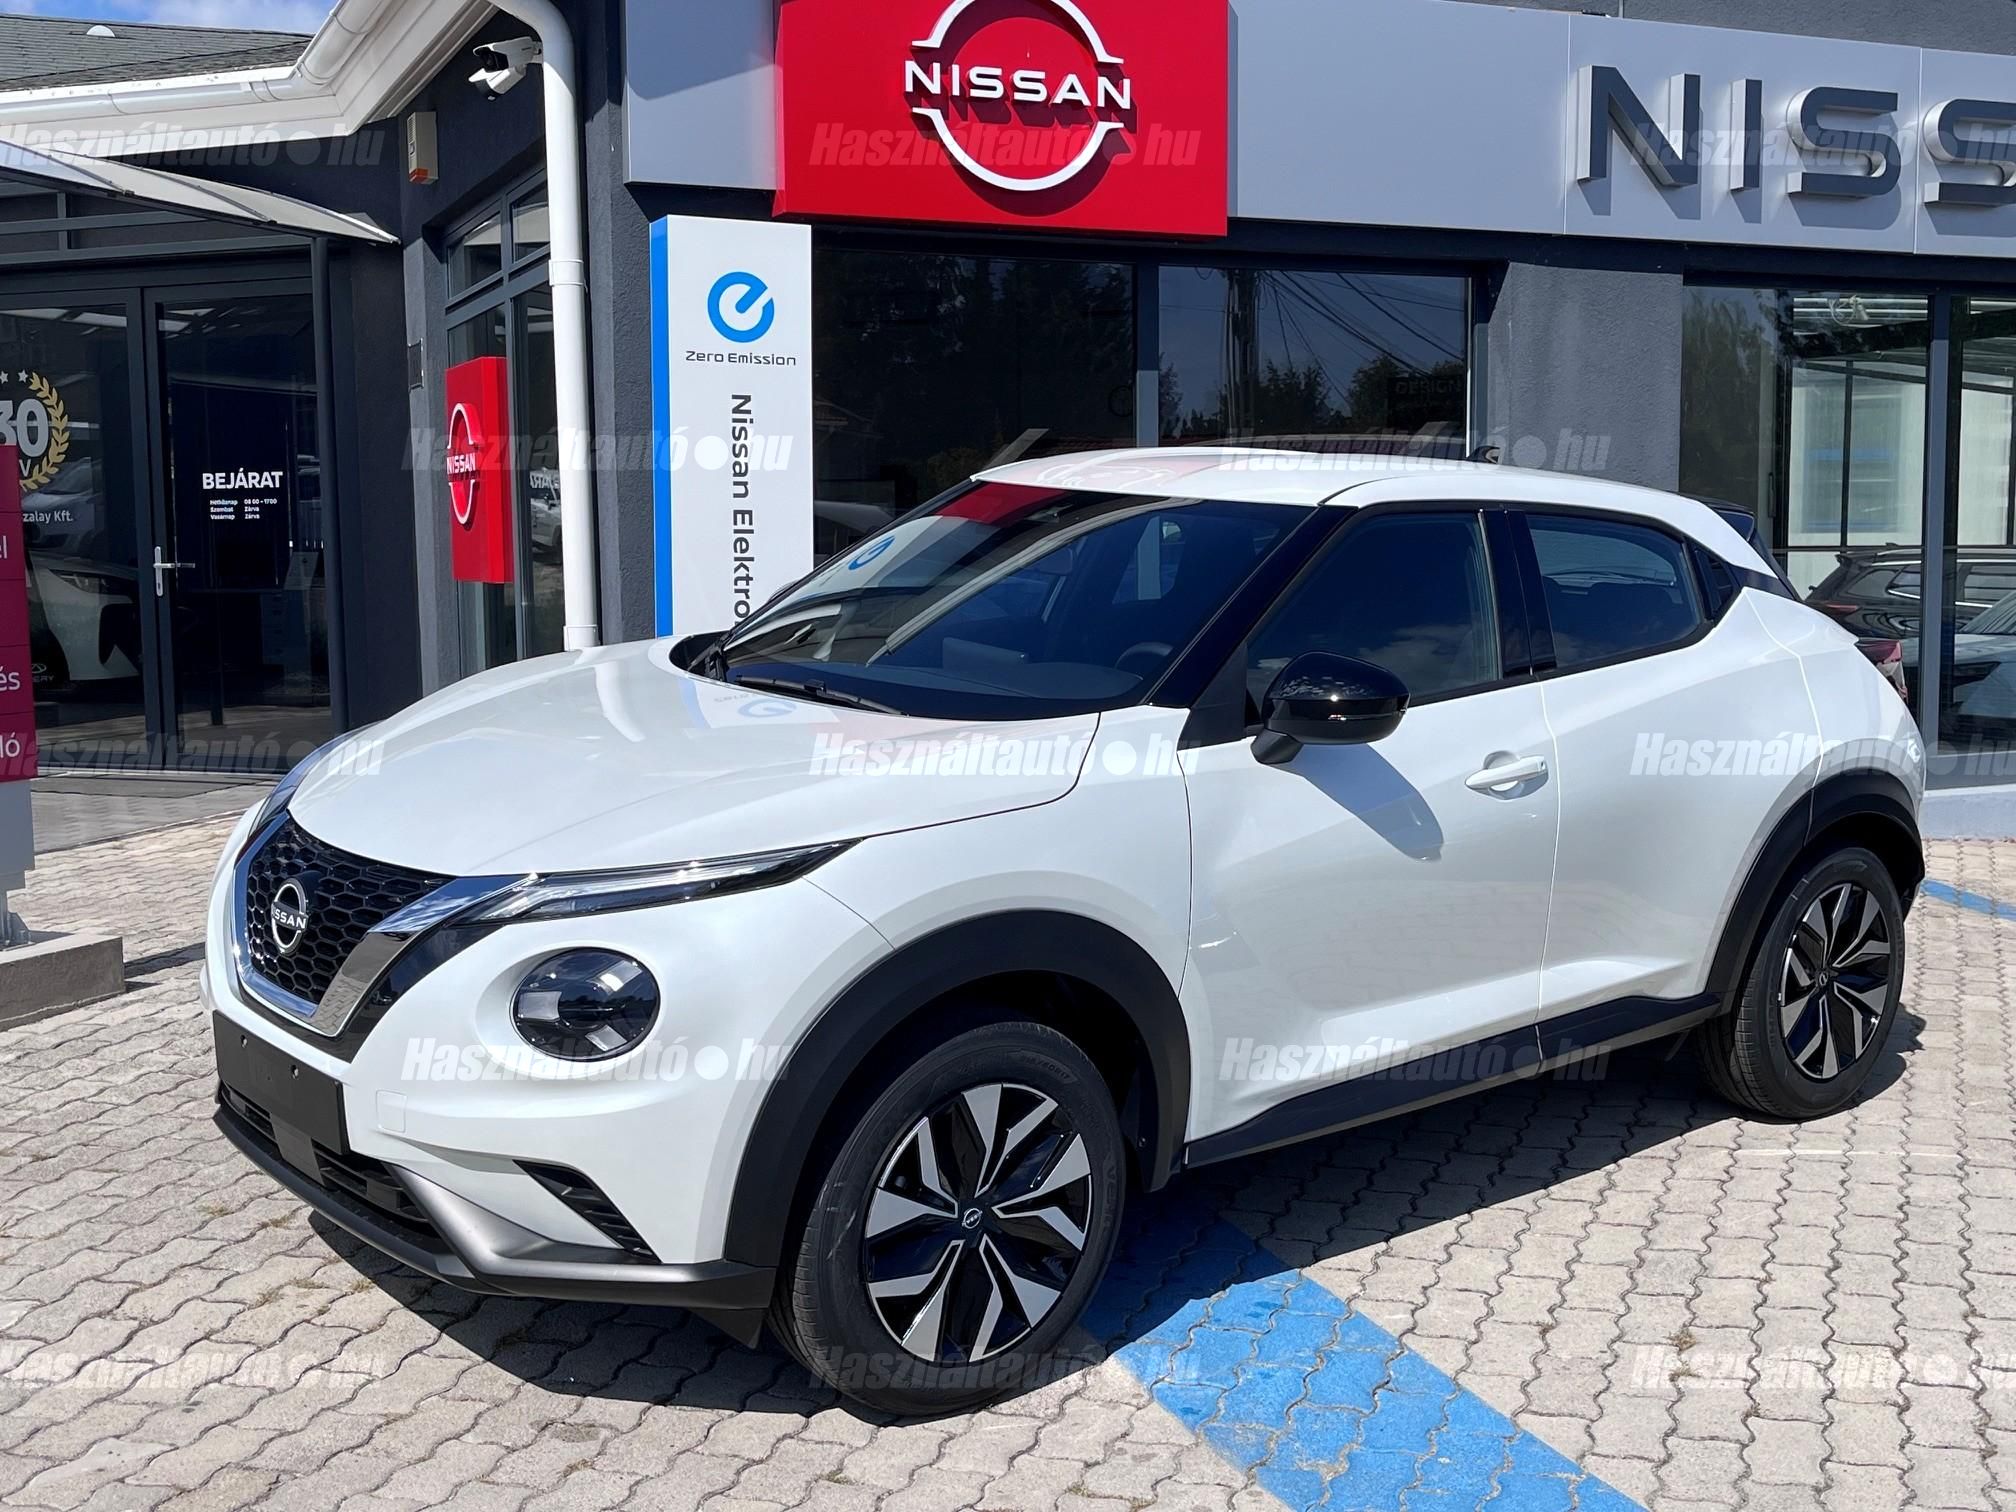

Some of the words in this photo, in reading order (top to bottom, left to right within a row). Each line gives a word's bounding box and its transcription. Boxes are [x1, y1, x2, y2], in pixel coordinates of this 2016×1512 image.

[904, 59, 1132, 110] NISSAN
[685, 350, 724, 363] Zero
[727, 352, 797, 367] Emission
[731, 393, 755, 499] Nissan
[446, 453, 477, 475] NISSAN
[202, 467, 284, 490] BEJÁRAT
[23, 510, 52, 524] zalay
[53, 510, 74, 522] Kft.
[732, 508, 756, 626] Elektro
[273, 907, 307, 929] SSAN
